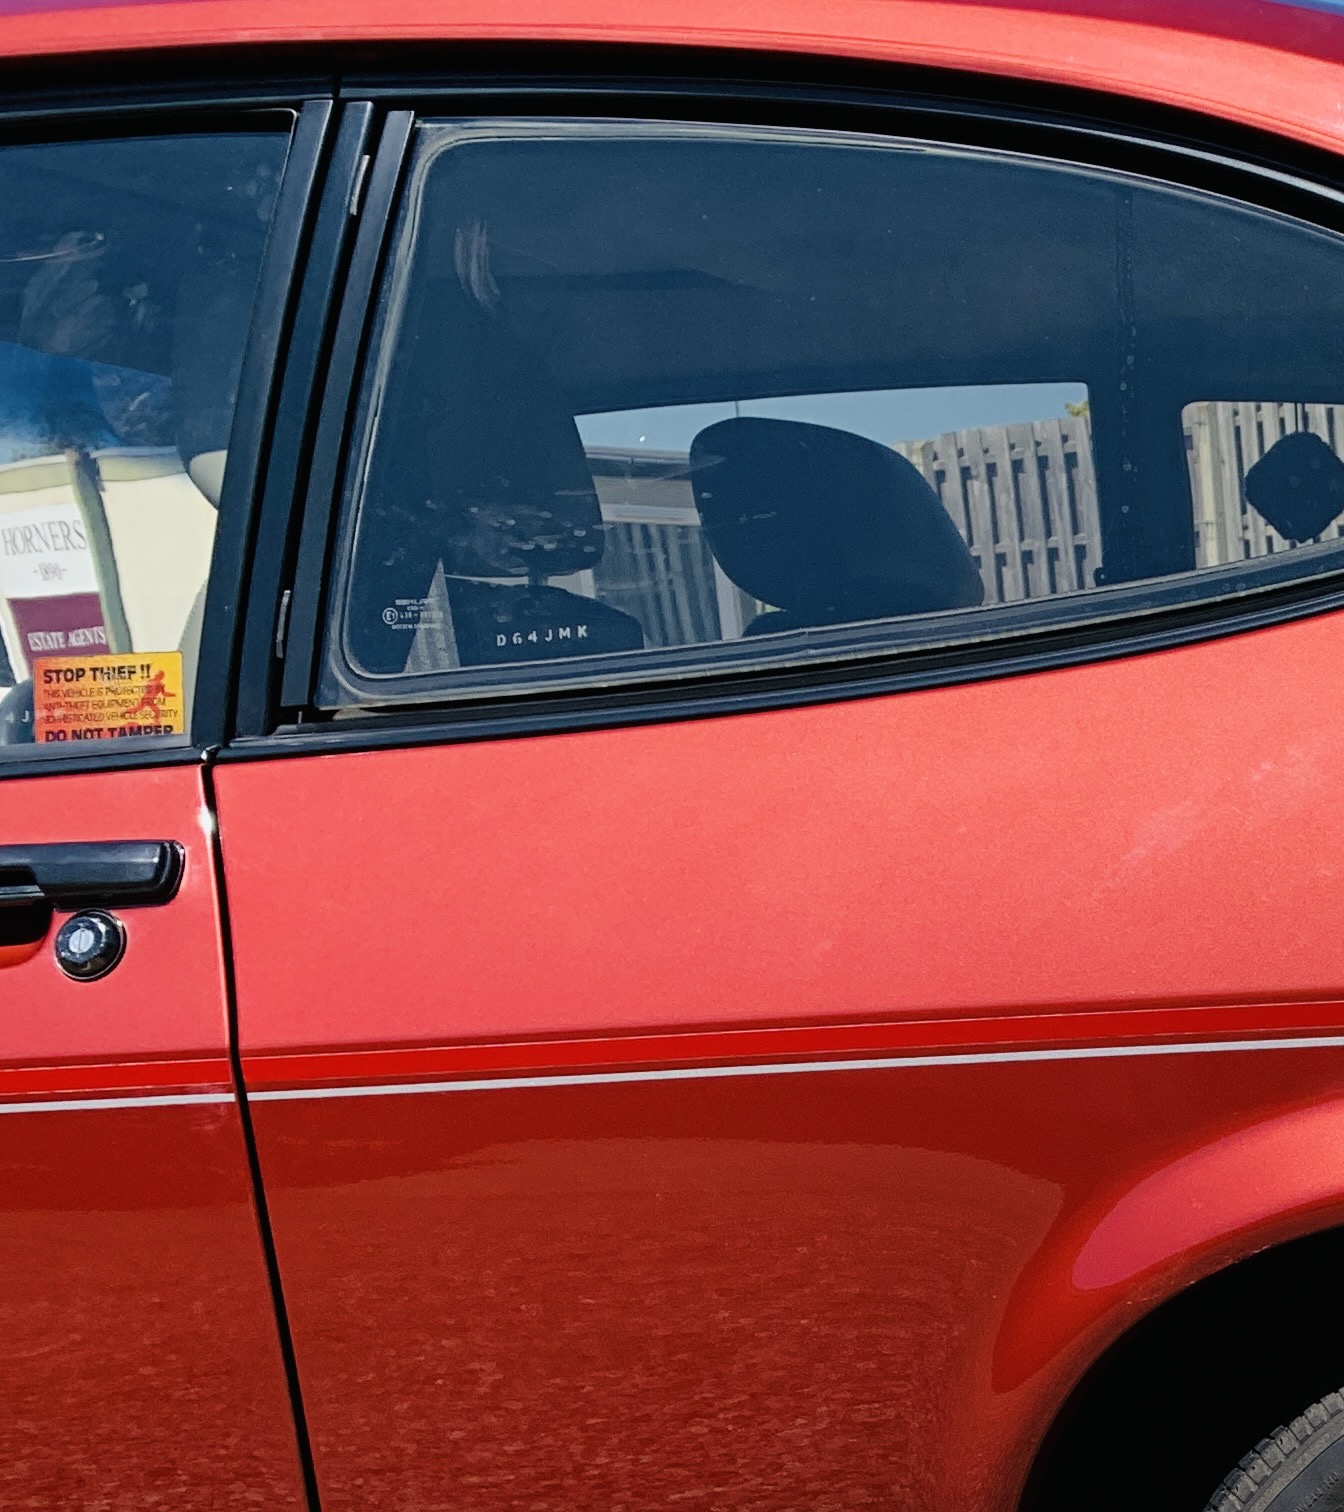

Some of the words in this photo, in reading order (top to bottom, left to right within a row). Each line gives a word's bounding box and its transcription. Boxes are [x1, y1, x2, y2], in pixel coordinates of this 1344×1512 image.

[1, 520, 87, 555] HORNERS
[27, 631, 66, 651] ESTATE
[68, 626, 107, 647] AGENTS
[44, 668, 85, 684] STOP
[90, 665, 136, 682] THIEF
[45, 729, 66, 742] DO
[71, 727, 103, 741] NOT
